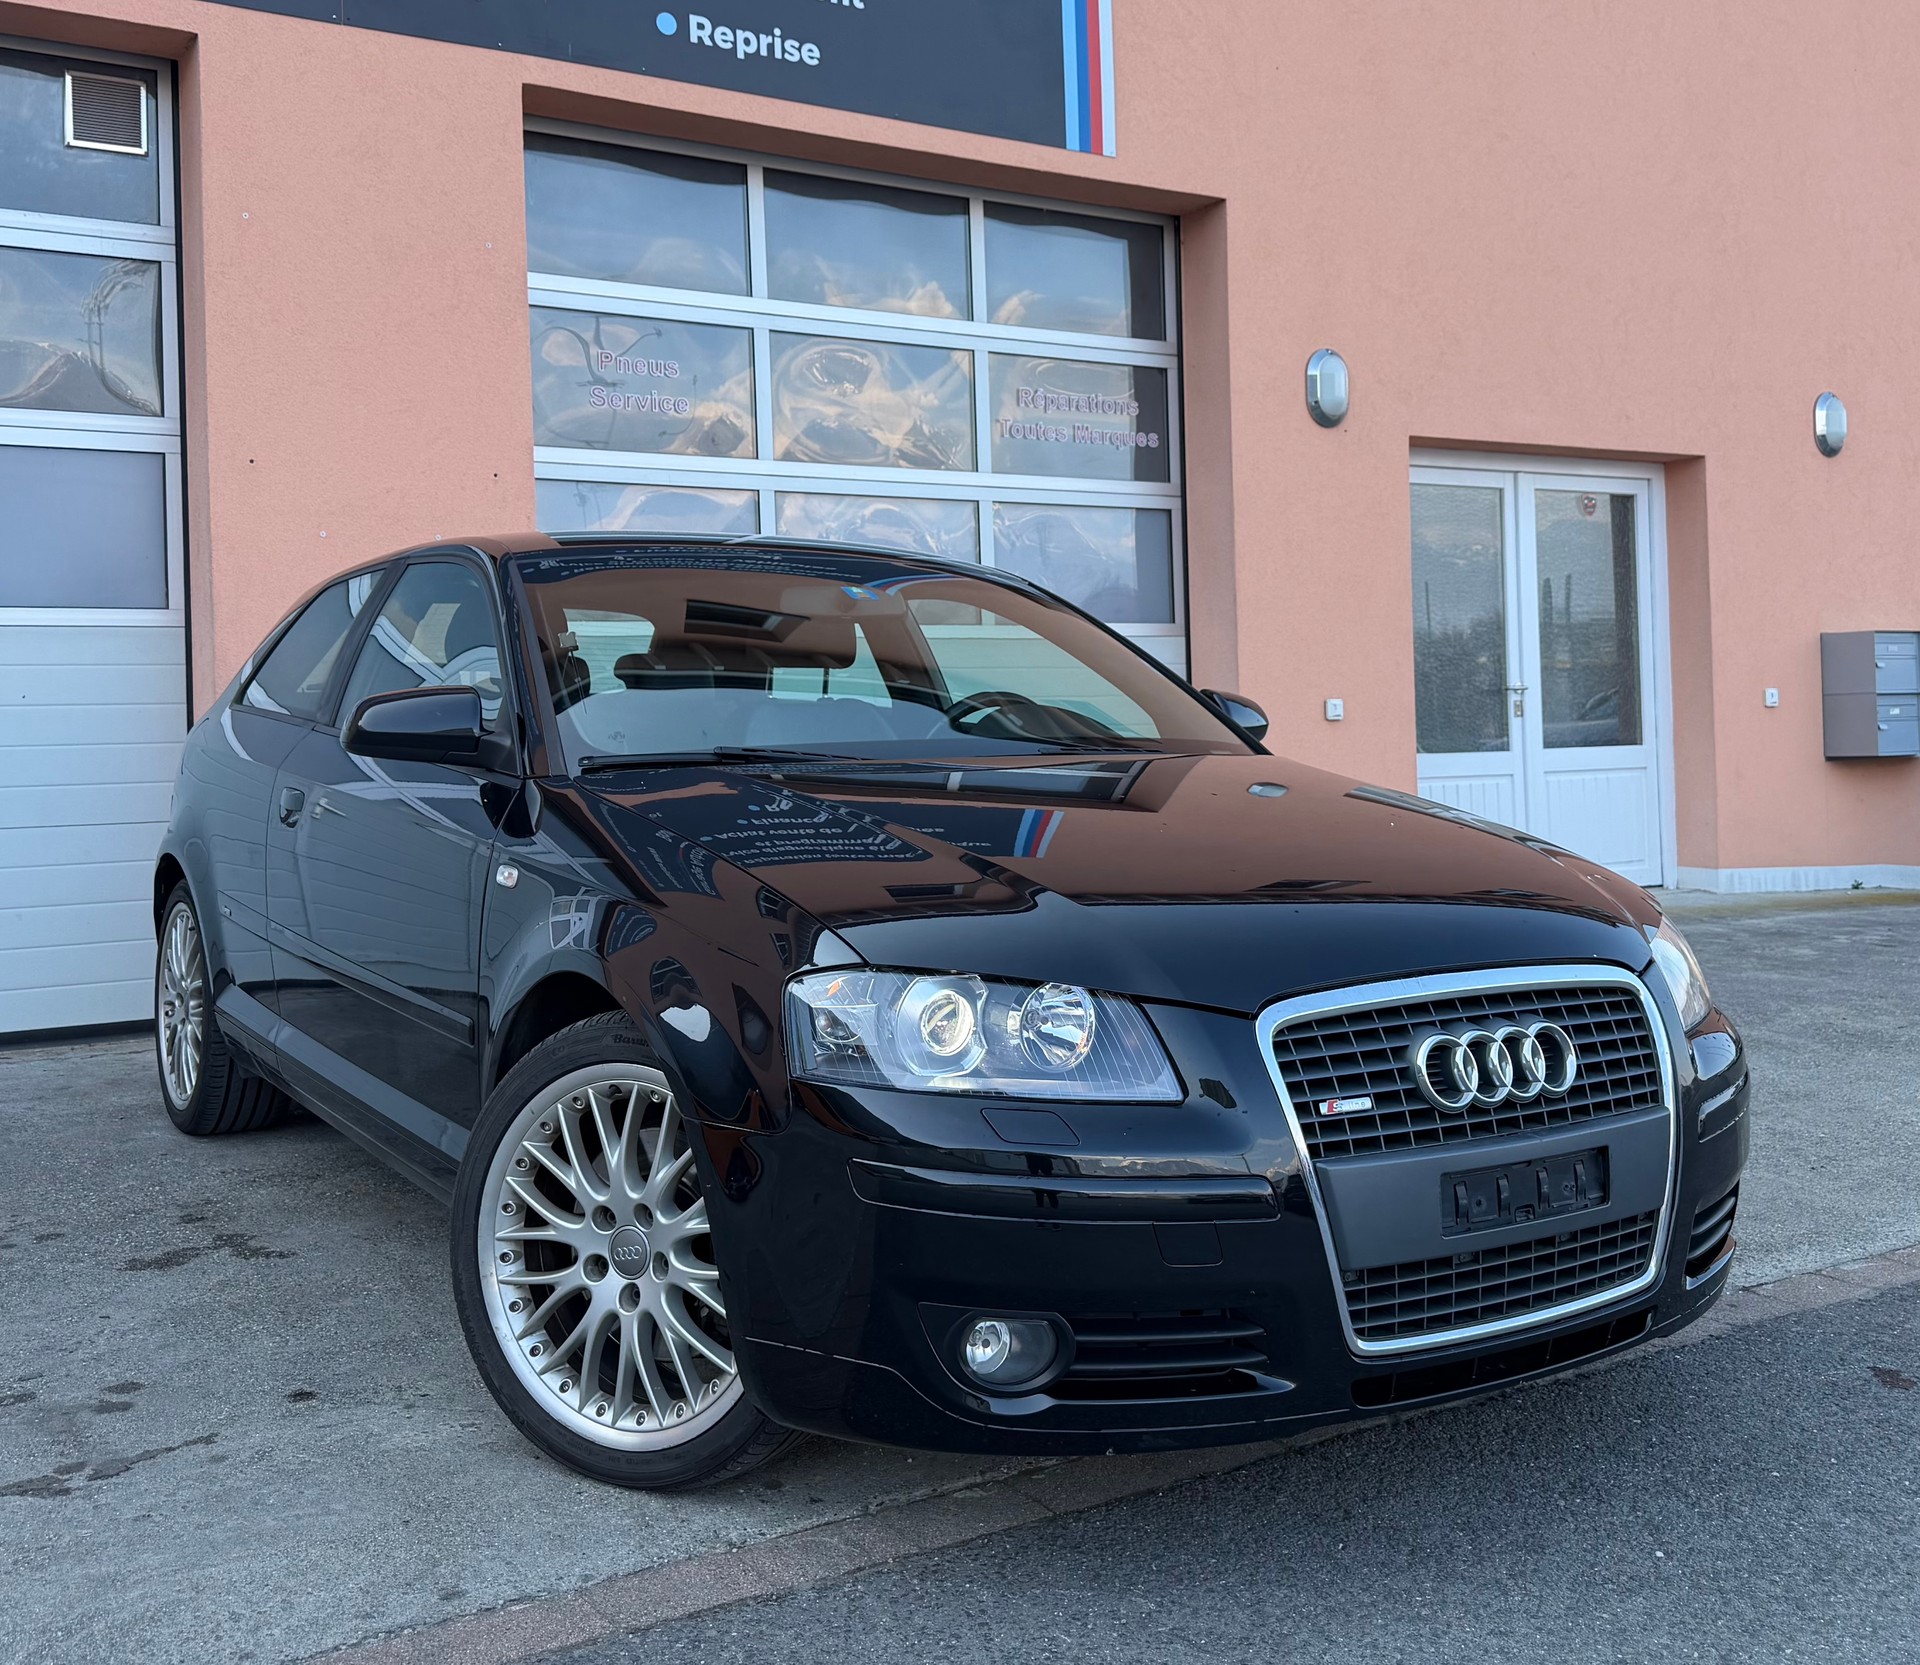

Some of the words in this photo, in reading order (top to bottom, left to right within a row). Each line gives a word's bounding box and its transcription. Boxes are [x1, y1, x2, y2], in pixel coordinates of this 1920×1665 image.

[688, 13, 821, 66] Reprise
[598, 349, 680, 378] Pneus
[589, 385, 690, 415] Service
[1018, 387, 1140, 416] Réparations
[999, 418, 1069, 443] Toutes
[1073, 423, 1160, 450] Marques
